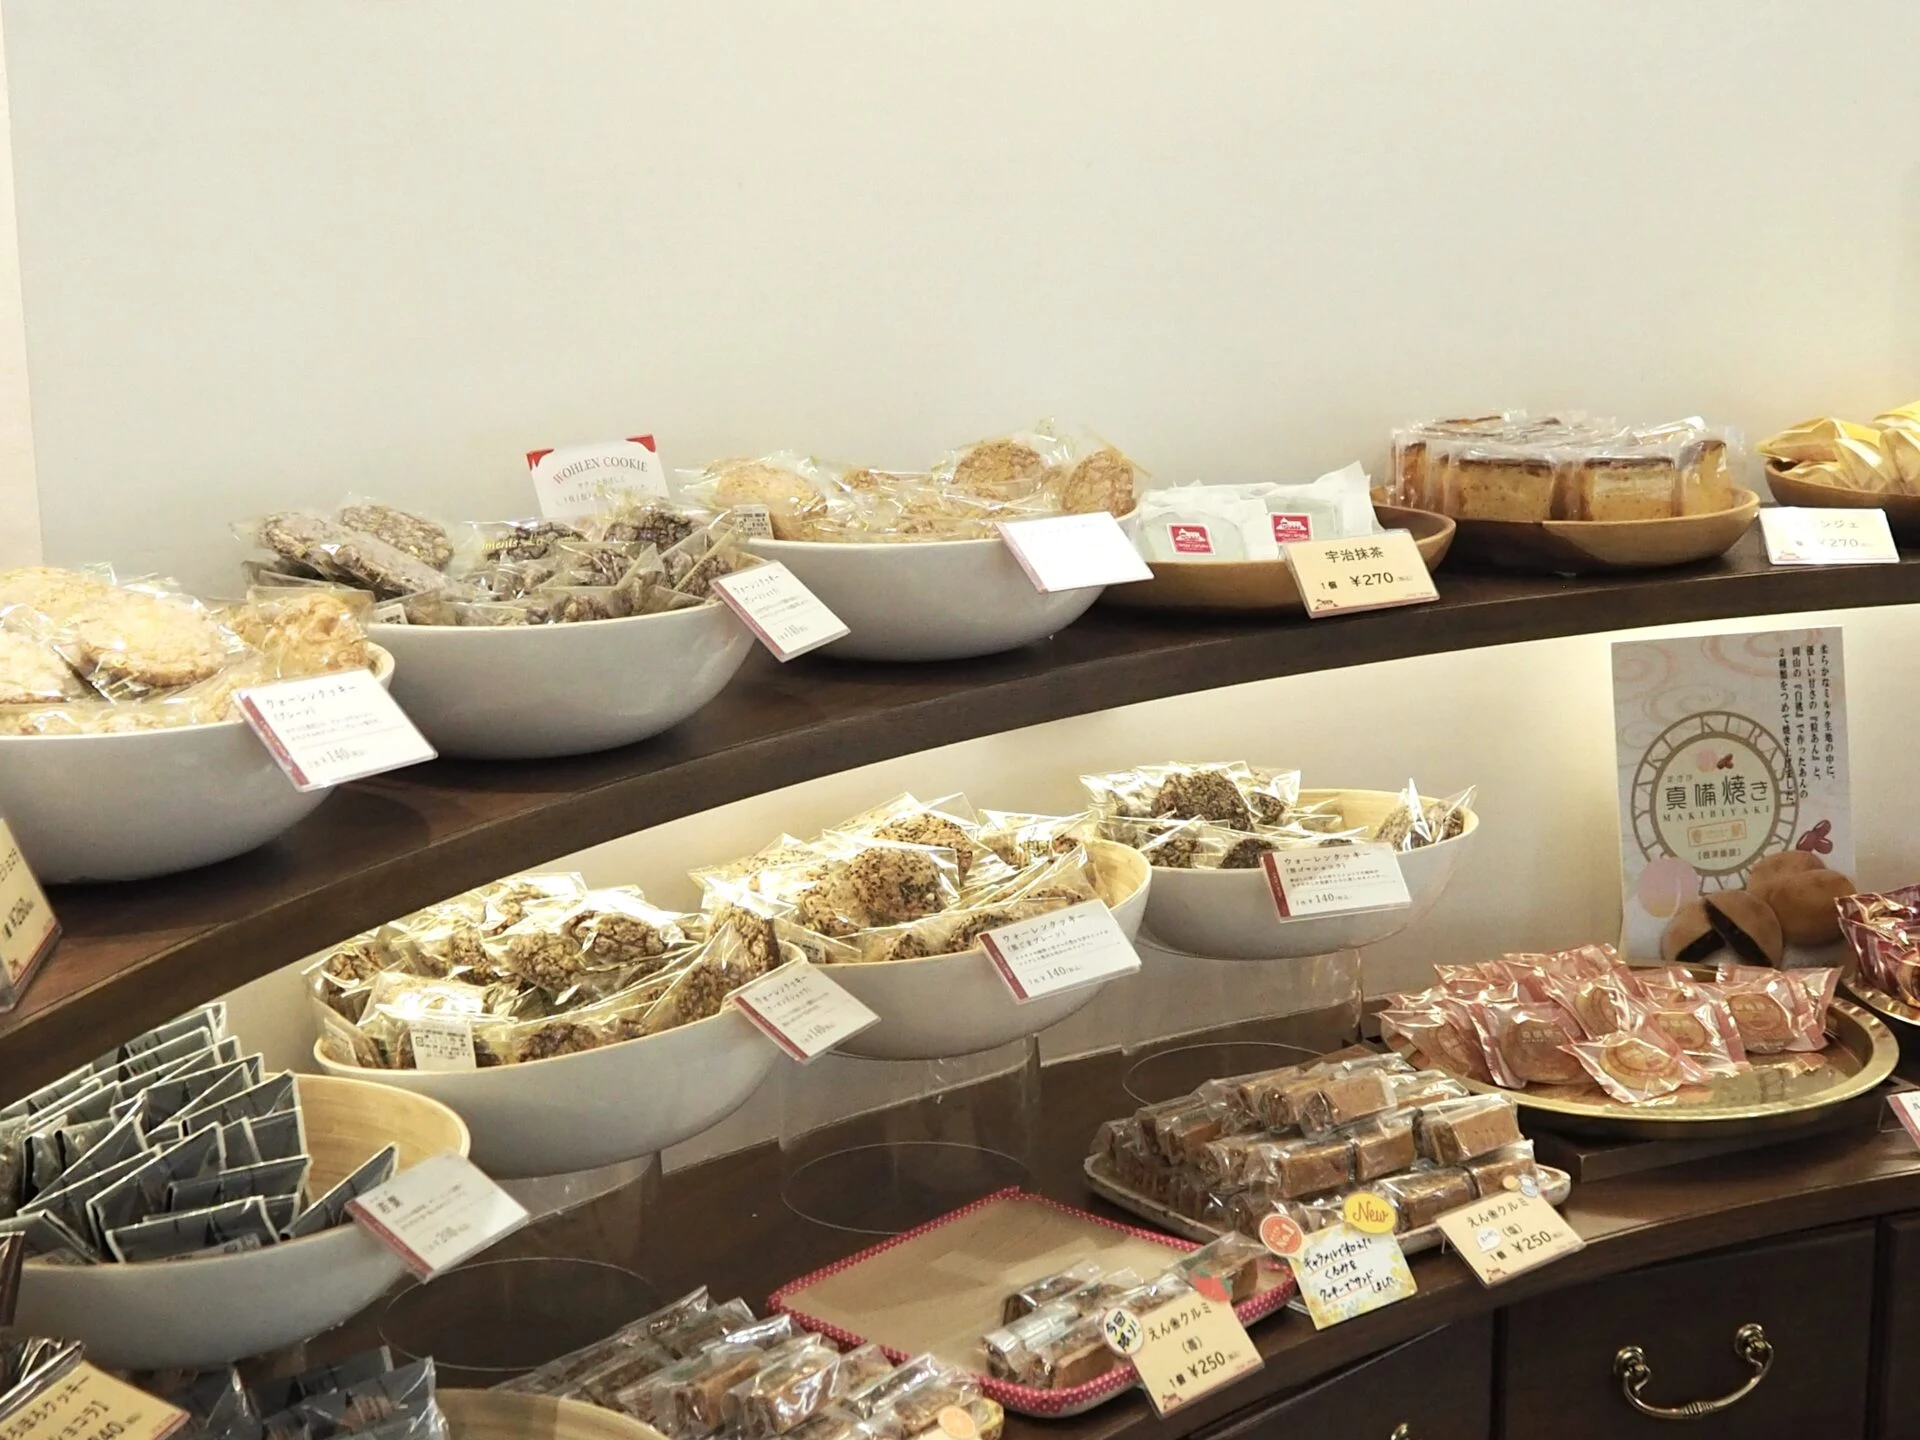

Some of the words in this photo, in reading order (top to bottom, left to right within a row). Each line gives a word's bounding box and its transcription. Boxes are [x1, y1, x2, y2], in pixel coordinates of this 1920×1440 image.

[553, 457, 601, 485] WOHLEN
[603, 456, 648, 473] COOKIE
[1325, 546, 1385, 564] 宇治抹茶
[1349, 571, 1394, 587] ¥270
[1665, 775, 1769, 811] 真備焼き
[1002, 913, 1087, 943] ウォーレンクッキー
[1352, 1201, 1390, 1225] New
[1510, 1230, 1552, 1254] ¥250
[1187, 1350, 1226, 1380] ¥250
